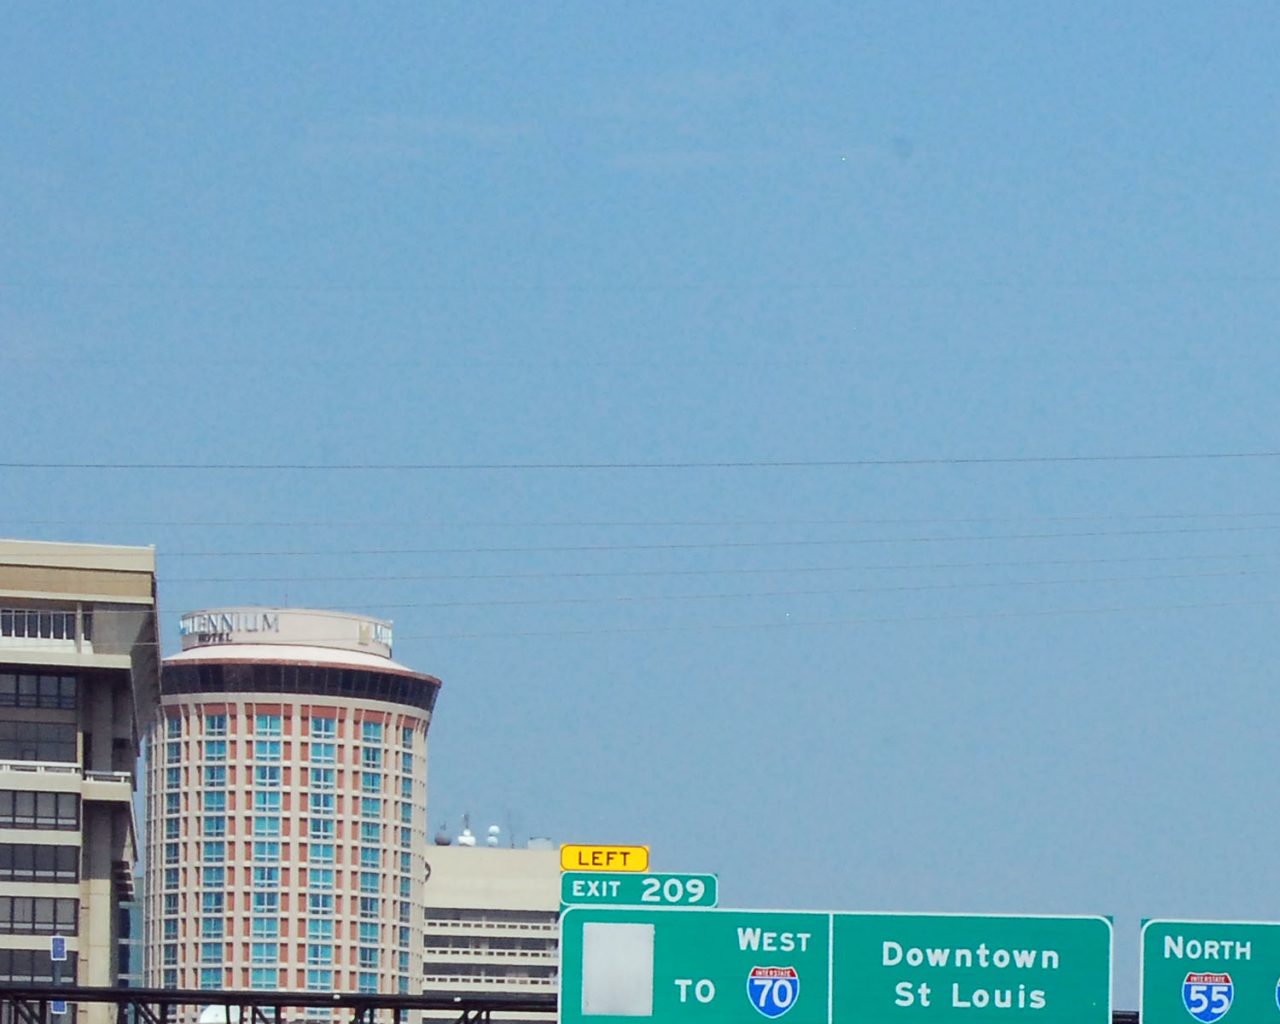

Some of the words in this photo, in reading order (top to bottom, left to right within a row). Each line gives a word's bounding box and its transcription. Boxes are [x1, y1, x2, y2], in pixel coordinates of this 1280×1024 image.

[198, 632, 232, 643] HOTEL
[578, 851, 630, 867] LEFT
[572, 880, 621, 897] EXIT
[641, 878, 705, 903] 209
[737, 928, 811, 953] WEST
[1164, 935, 1251, 960] NORTH
[882, 941, 1060, 969] Downtown
[1190, 975, 1226, 984] INTERSTATE
[675, 979, 715, 1003] TO
[753, 979, 793, 1008] 70
[895, 982, 931, 1007] St
[952, 983, 1047, 1009] Louis
[1189, 986, 1230, 1014] 55
